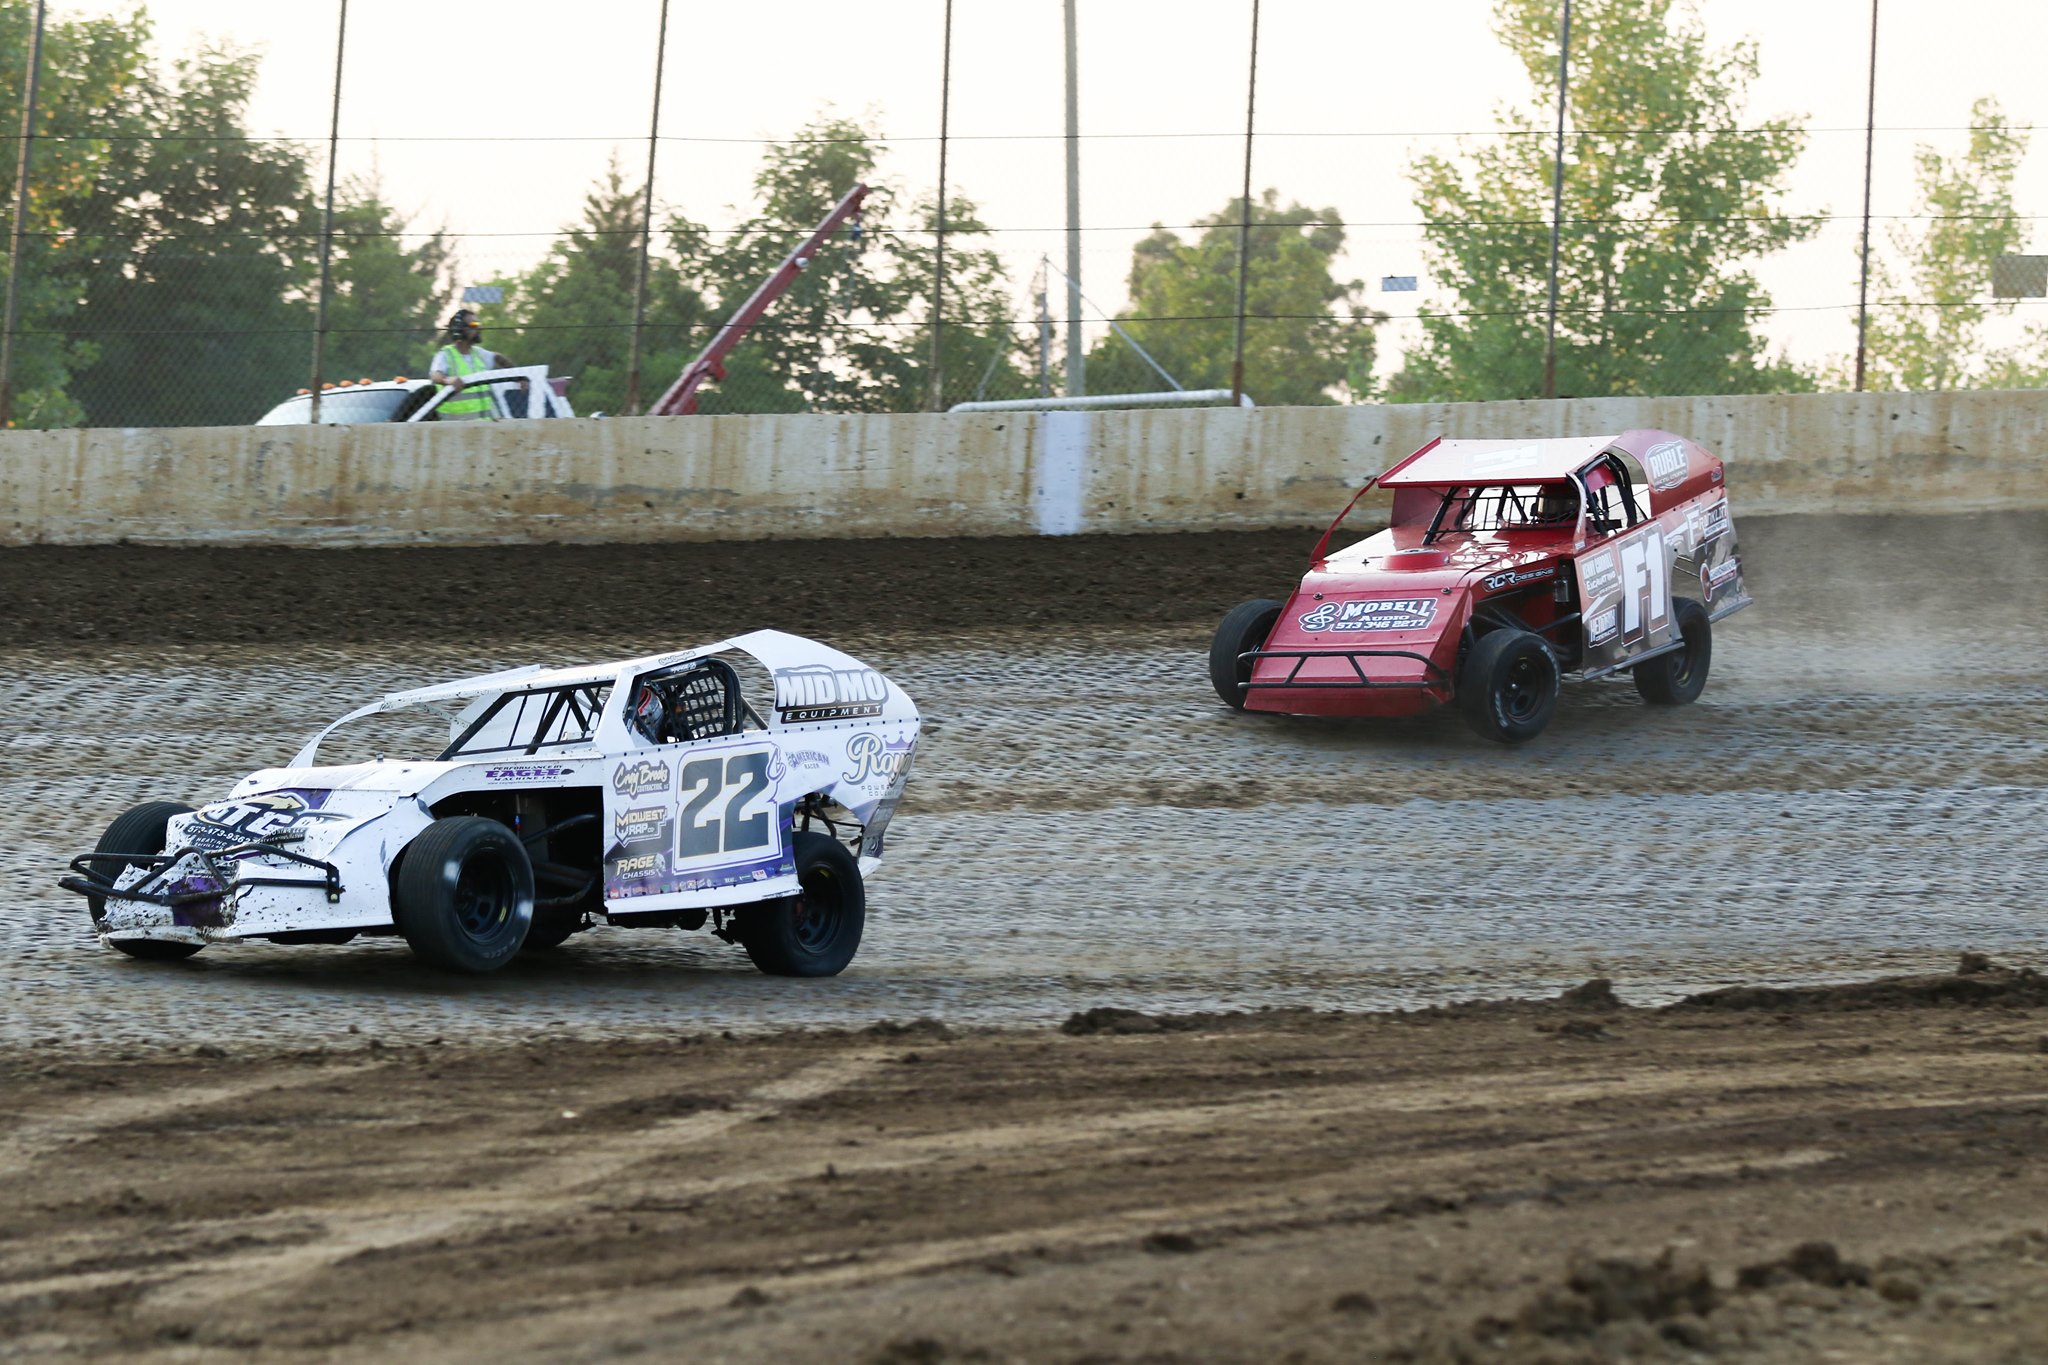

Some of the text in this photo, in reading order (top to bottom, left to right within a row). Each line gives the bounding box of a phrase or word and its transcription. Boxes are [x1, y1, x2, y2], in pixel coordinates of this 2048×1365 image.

[1649, 444, 1687, 479] RUBLE
[1621, 532, 1664, 634] F1
[1340, 600, 1431, 621] MOBELL
[1335, 621, 1363, 630] 573
[1363, 620, 1391, 629] 346
[775, 670, 887, 708] MID MO
[784, 704, 882, 721] EQUIPMENT
[485, 768, 561, 778] EAGLE
[679, 751, 770, 859] 22
[616, 808, 665, 827] MIDWEST
[616, 822, 648, 839] WRAP
[616, 854, 656, 877] RAGE
[622, 868, 656, 880] CHASSIS
